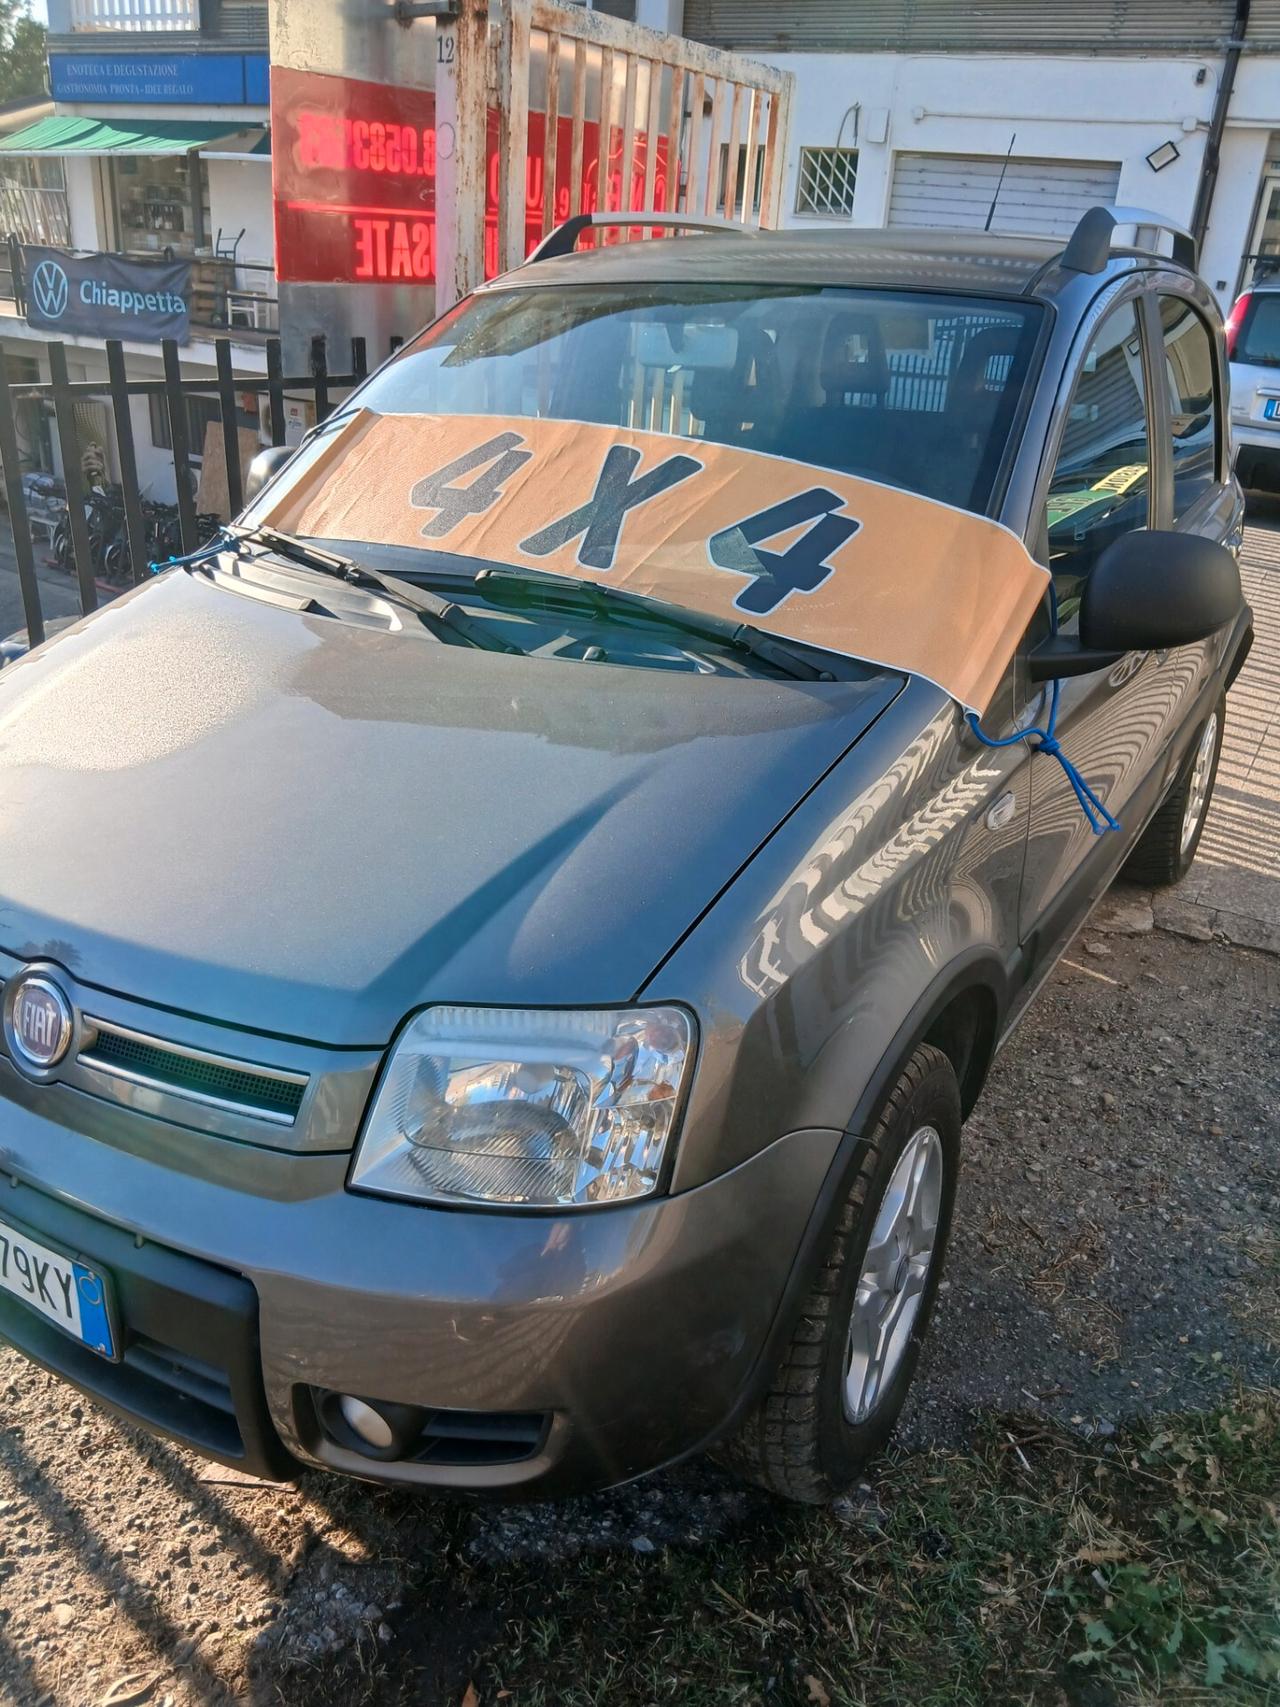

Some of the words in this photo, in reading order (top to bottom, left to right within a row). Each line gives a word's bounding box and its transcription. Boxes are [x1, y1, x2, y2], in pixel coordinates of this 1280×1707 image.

[437, 35, 454, 64] 12
[67, 64, 106, 76] ENOTECA
[107, 64, 113, 76] E
[113, 64, 178, 76] DEGUSTAZIONE
[56, 83, 107, 95] GASTRONOMIA
[110, 84, 140, 95] PRONTA
[164, 84, 194, 95] REGALO
[80, 279, 187, 315] Chiappetta
[23, 1000, 57, 1048] FIAT
